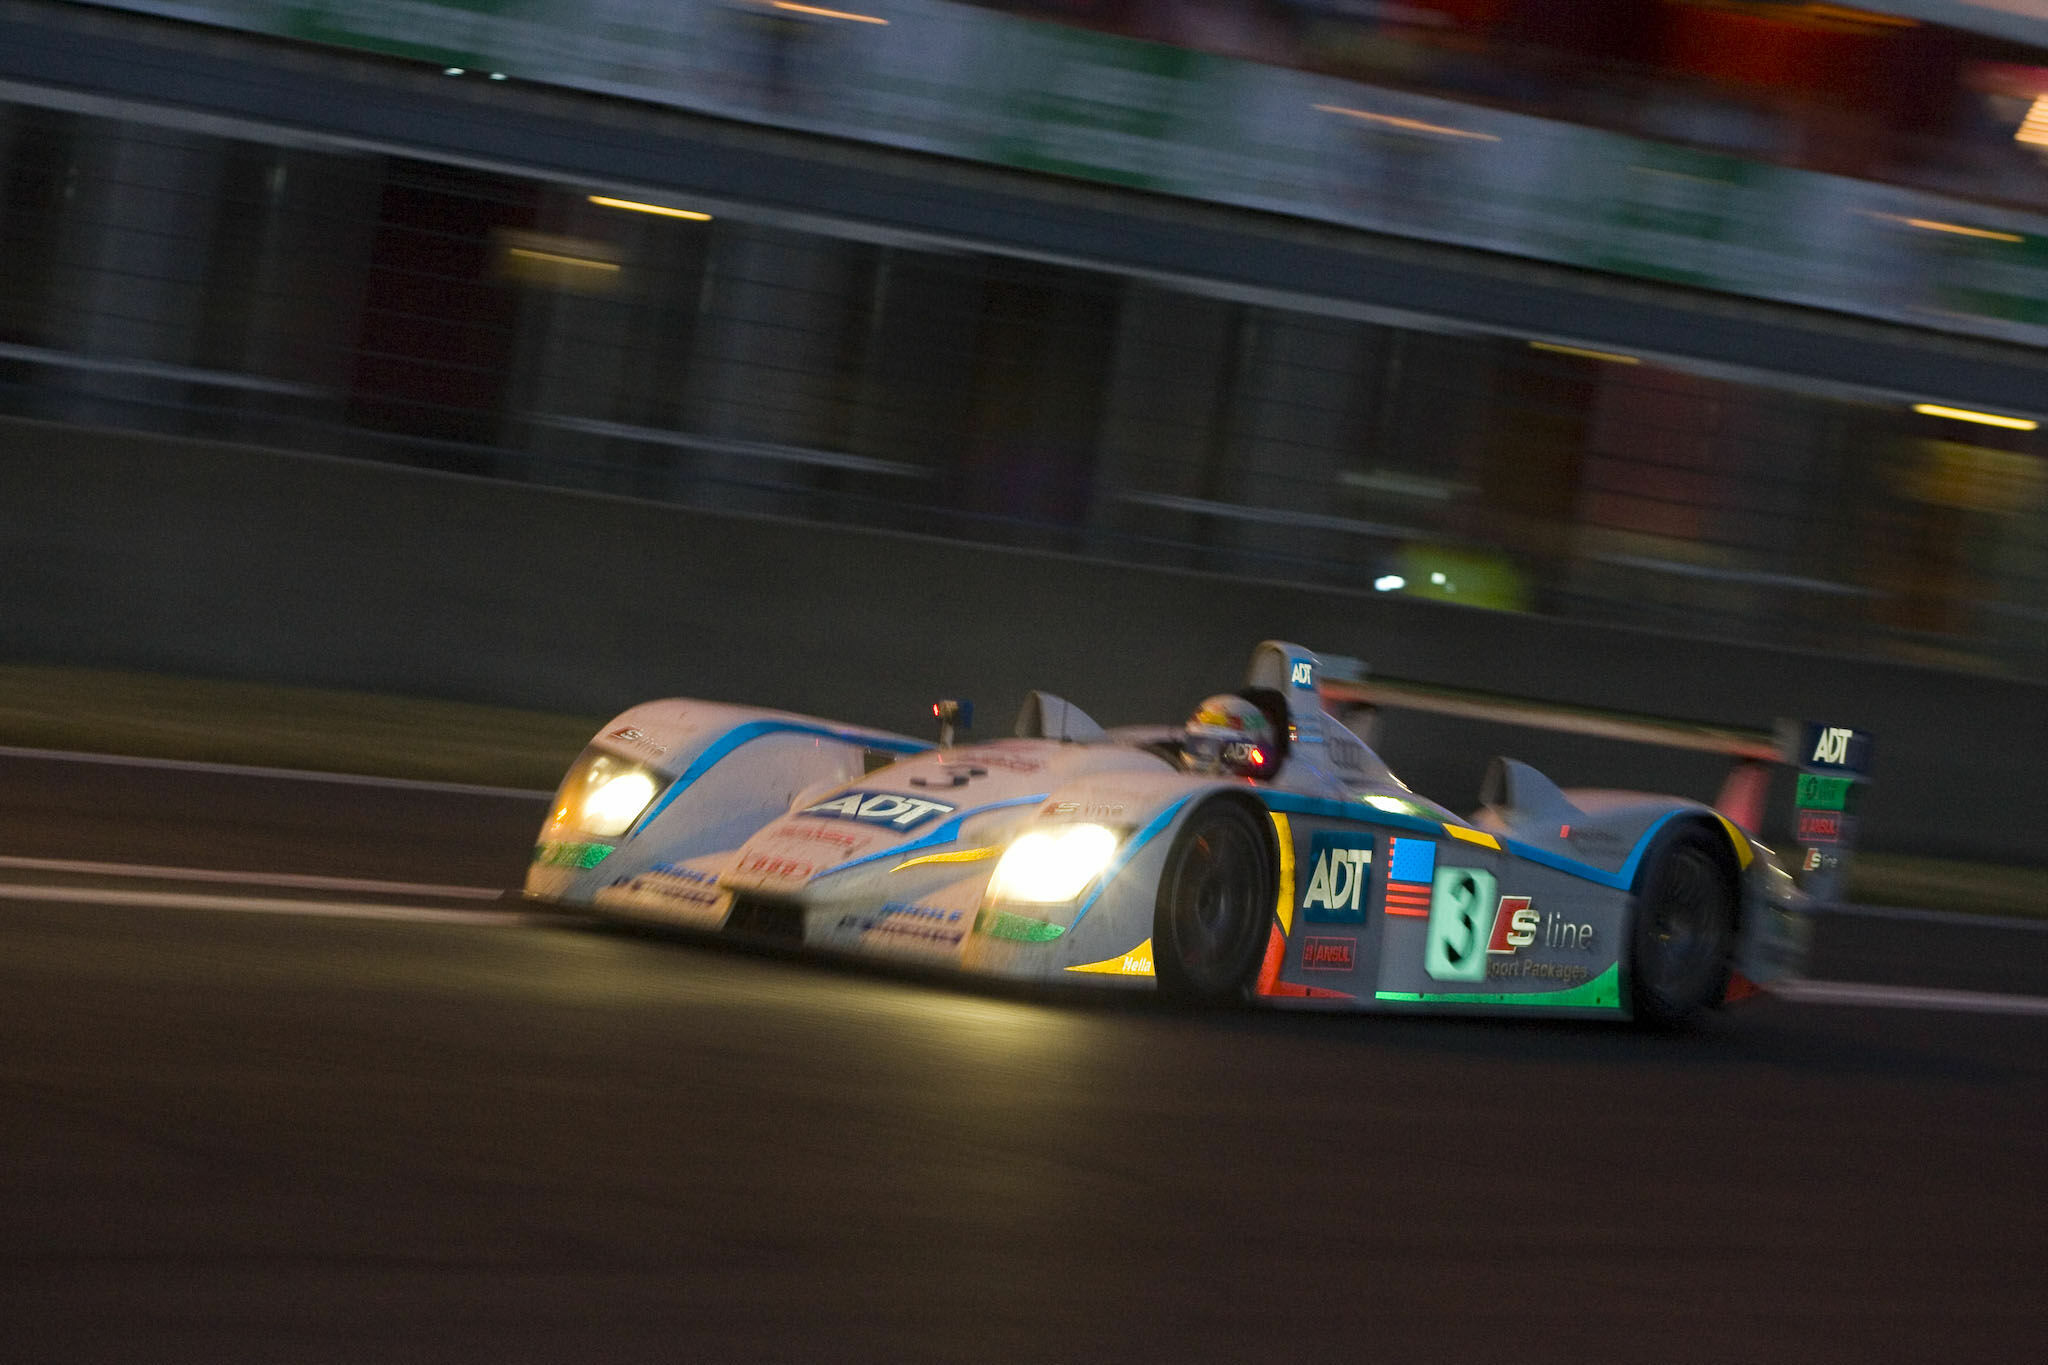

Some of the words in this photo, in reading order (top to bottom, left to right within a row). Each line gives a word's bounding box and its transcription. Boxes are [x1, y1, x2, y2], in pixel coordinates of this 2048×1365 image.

[1291, 663, 1312, 685] ADT
[1812, 727, 1853, 765] ADT
[803, 792, 955, 826] ADT
[1302, 848, 1373, 911] ADT
[1545, 911, 1594, 949] line
[1522, 958, 1588, 982] Packages
